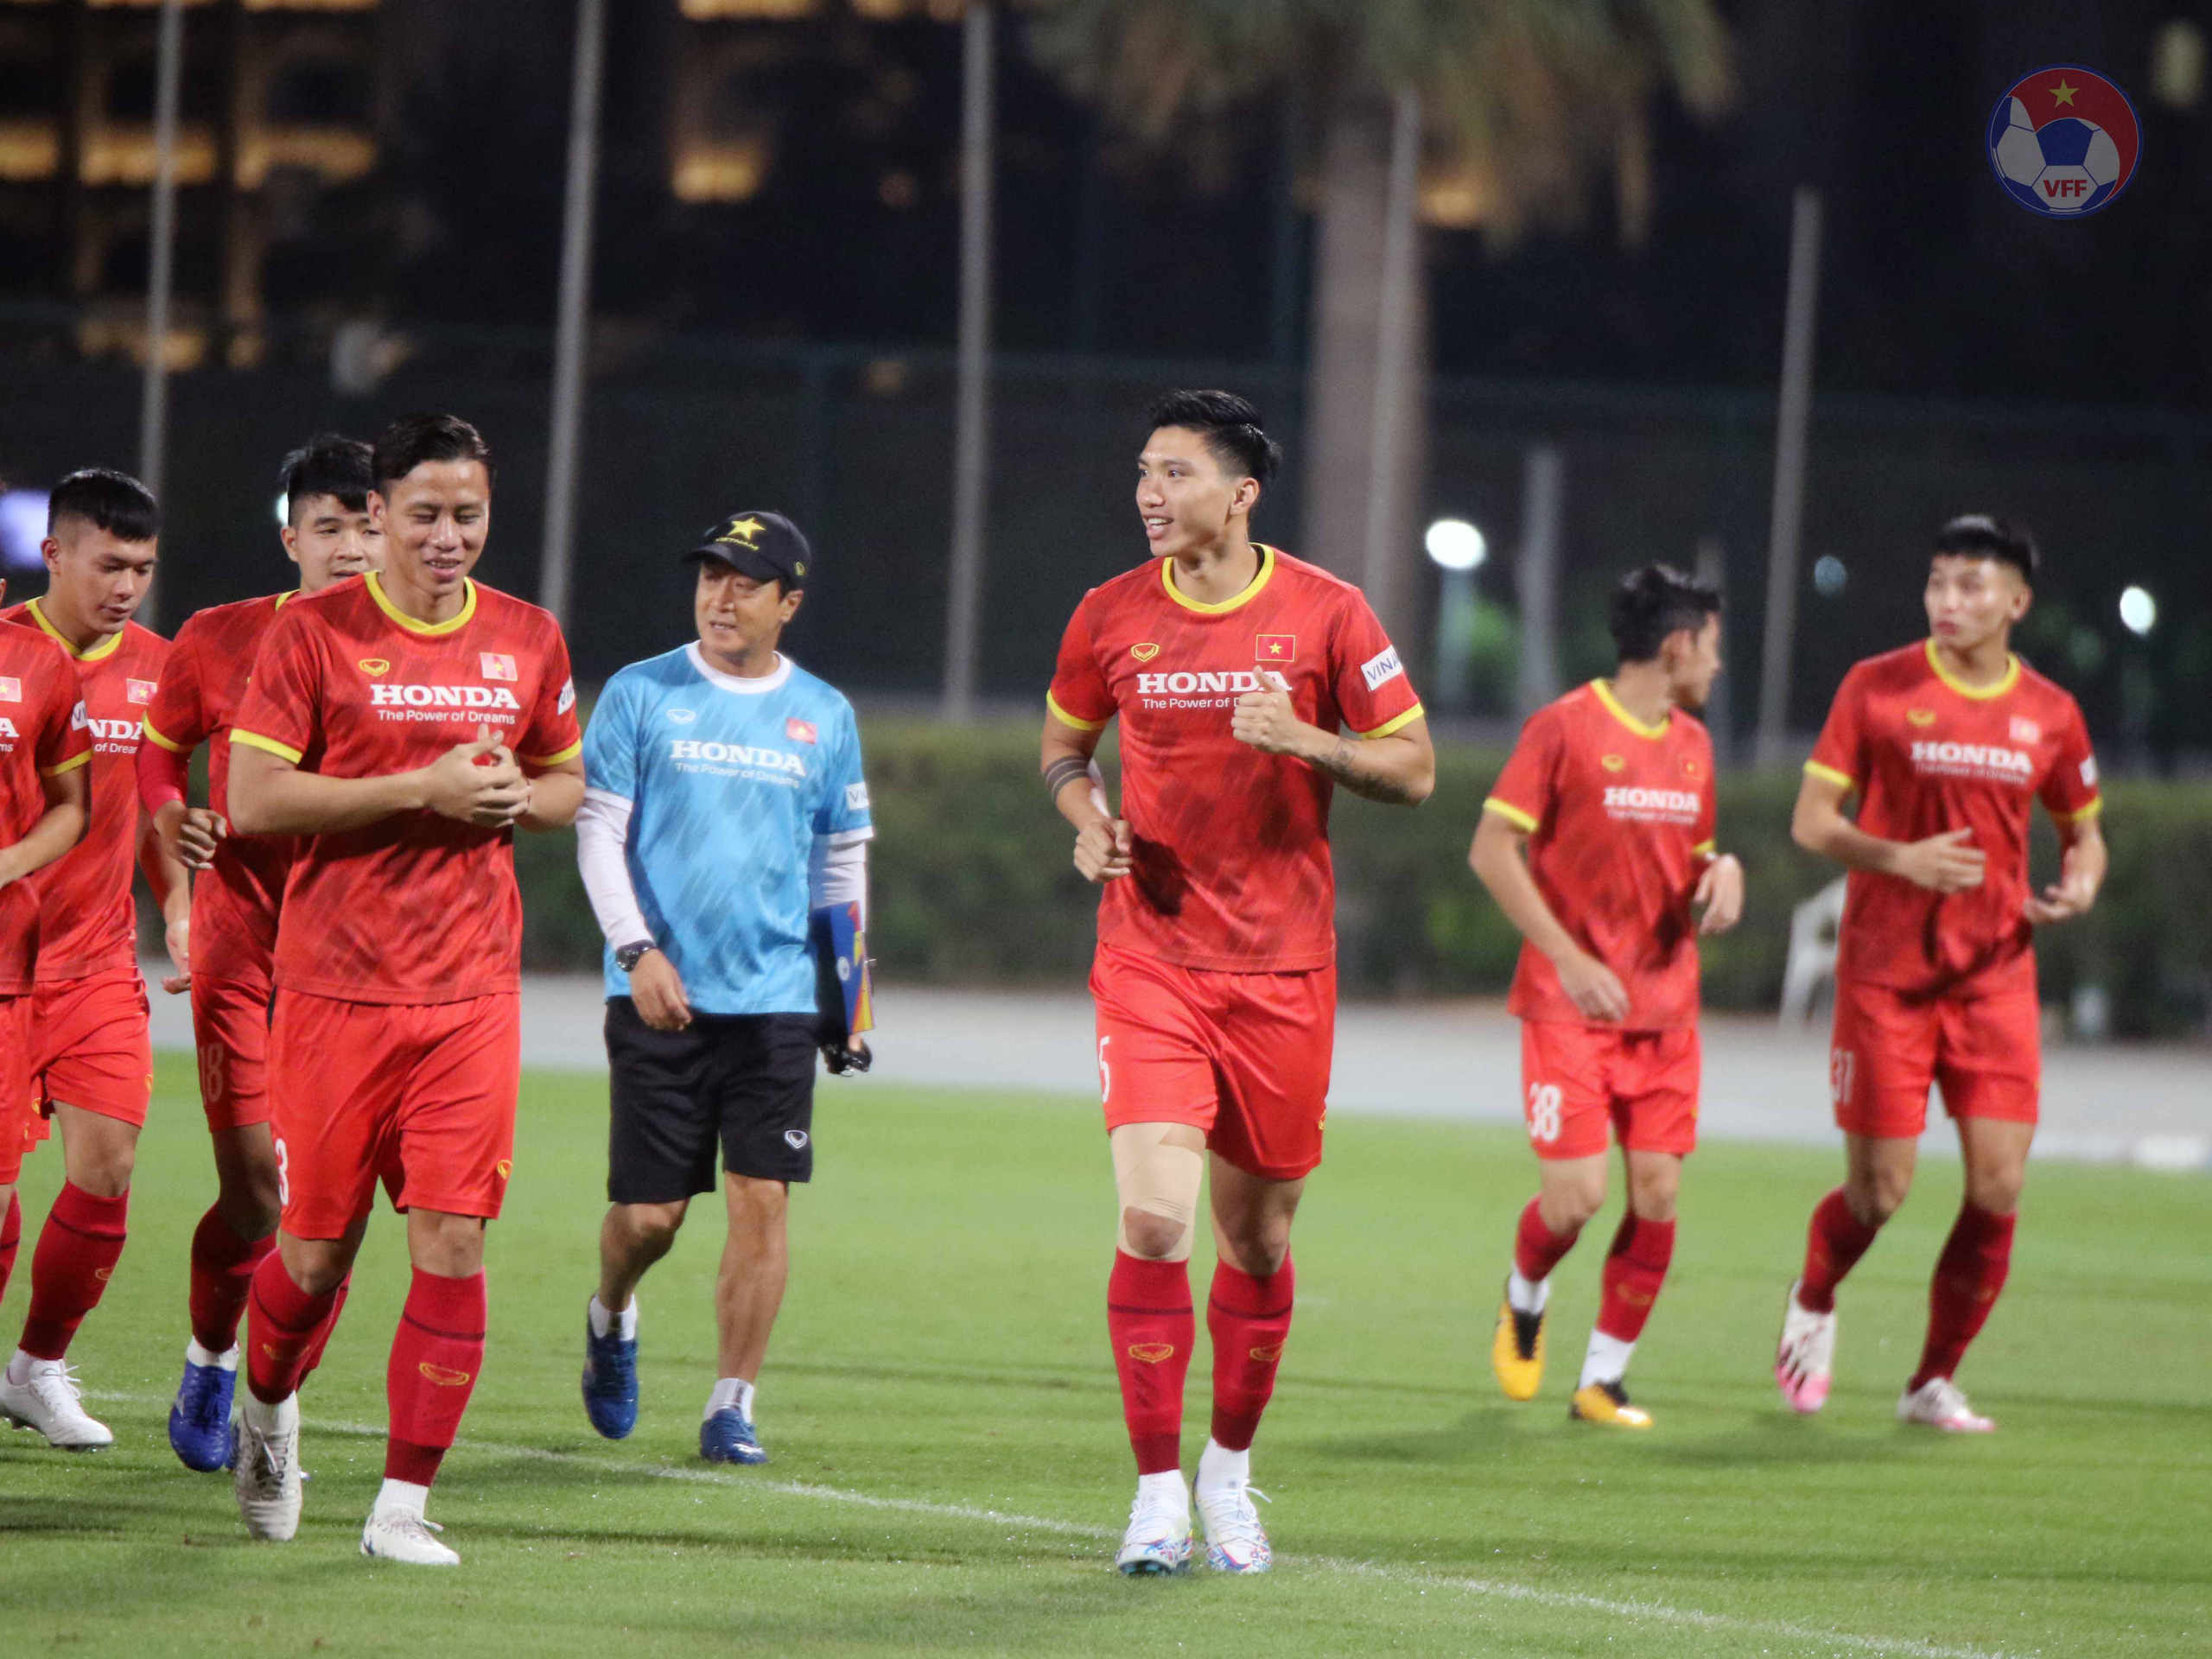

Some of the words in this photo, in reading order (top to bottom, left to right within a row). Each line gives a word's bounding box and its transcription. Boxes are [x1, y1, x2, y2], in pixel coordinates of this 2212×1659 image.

[1136, 671, 1293, 694] HONDA
[370, 684, 520, 709] HONDA
[1142, 698, 1166, 709] The
[1169, 697, 1212, 709] Power
[1215, 696, 1230, 708] of
[378, 709, 404, 721] The
[406, 710, 448, 722] Power
[451, 711, 465, 722] of
[468, 711, 515, 724] Dreams
[94, 742, 108, 752] of
[670, 740, 806, 777] HONDA
[1910, 741, 2032, 774] HONDA
[676, 763, 699, 772] The
[701, 764, 741, 777] Power
[741, 768, 755, 779] of
[756, 771, 800, 789] Dreams
[1603, 786, 1700, 811] HONDA
